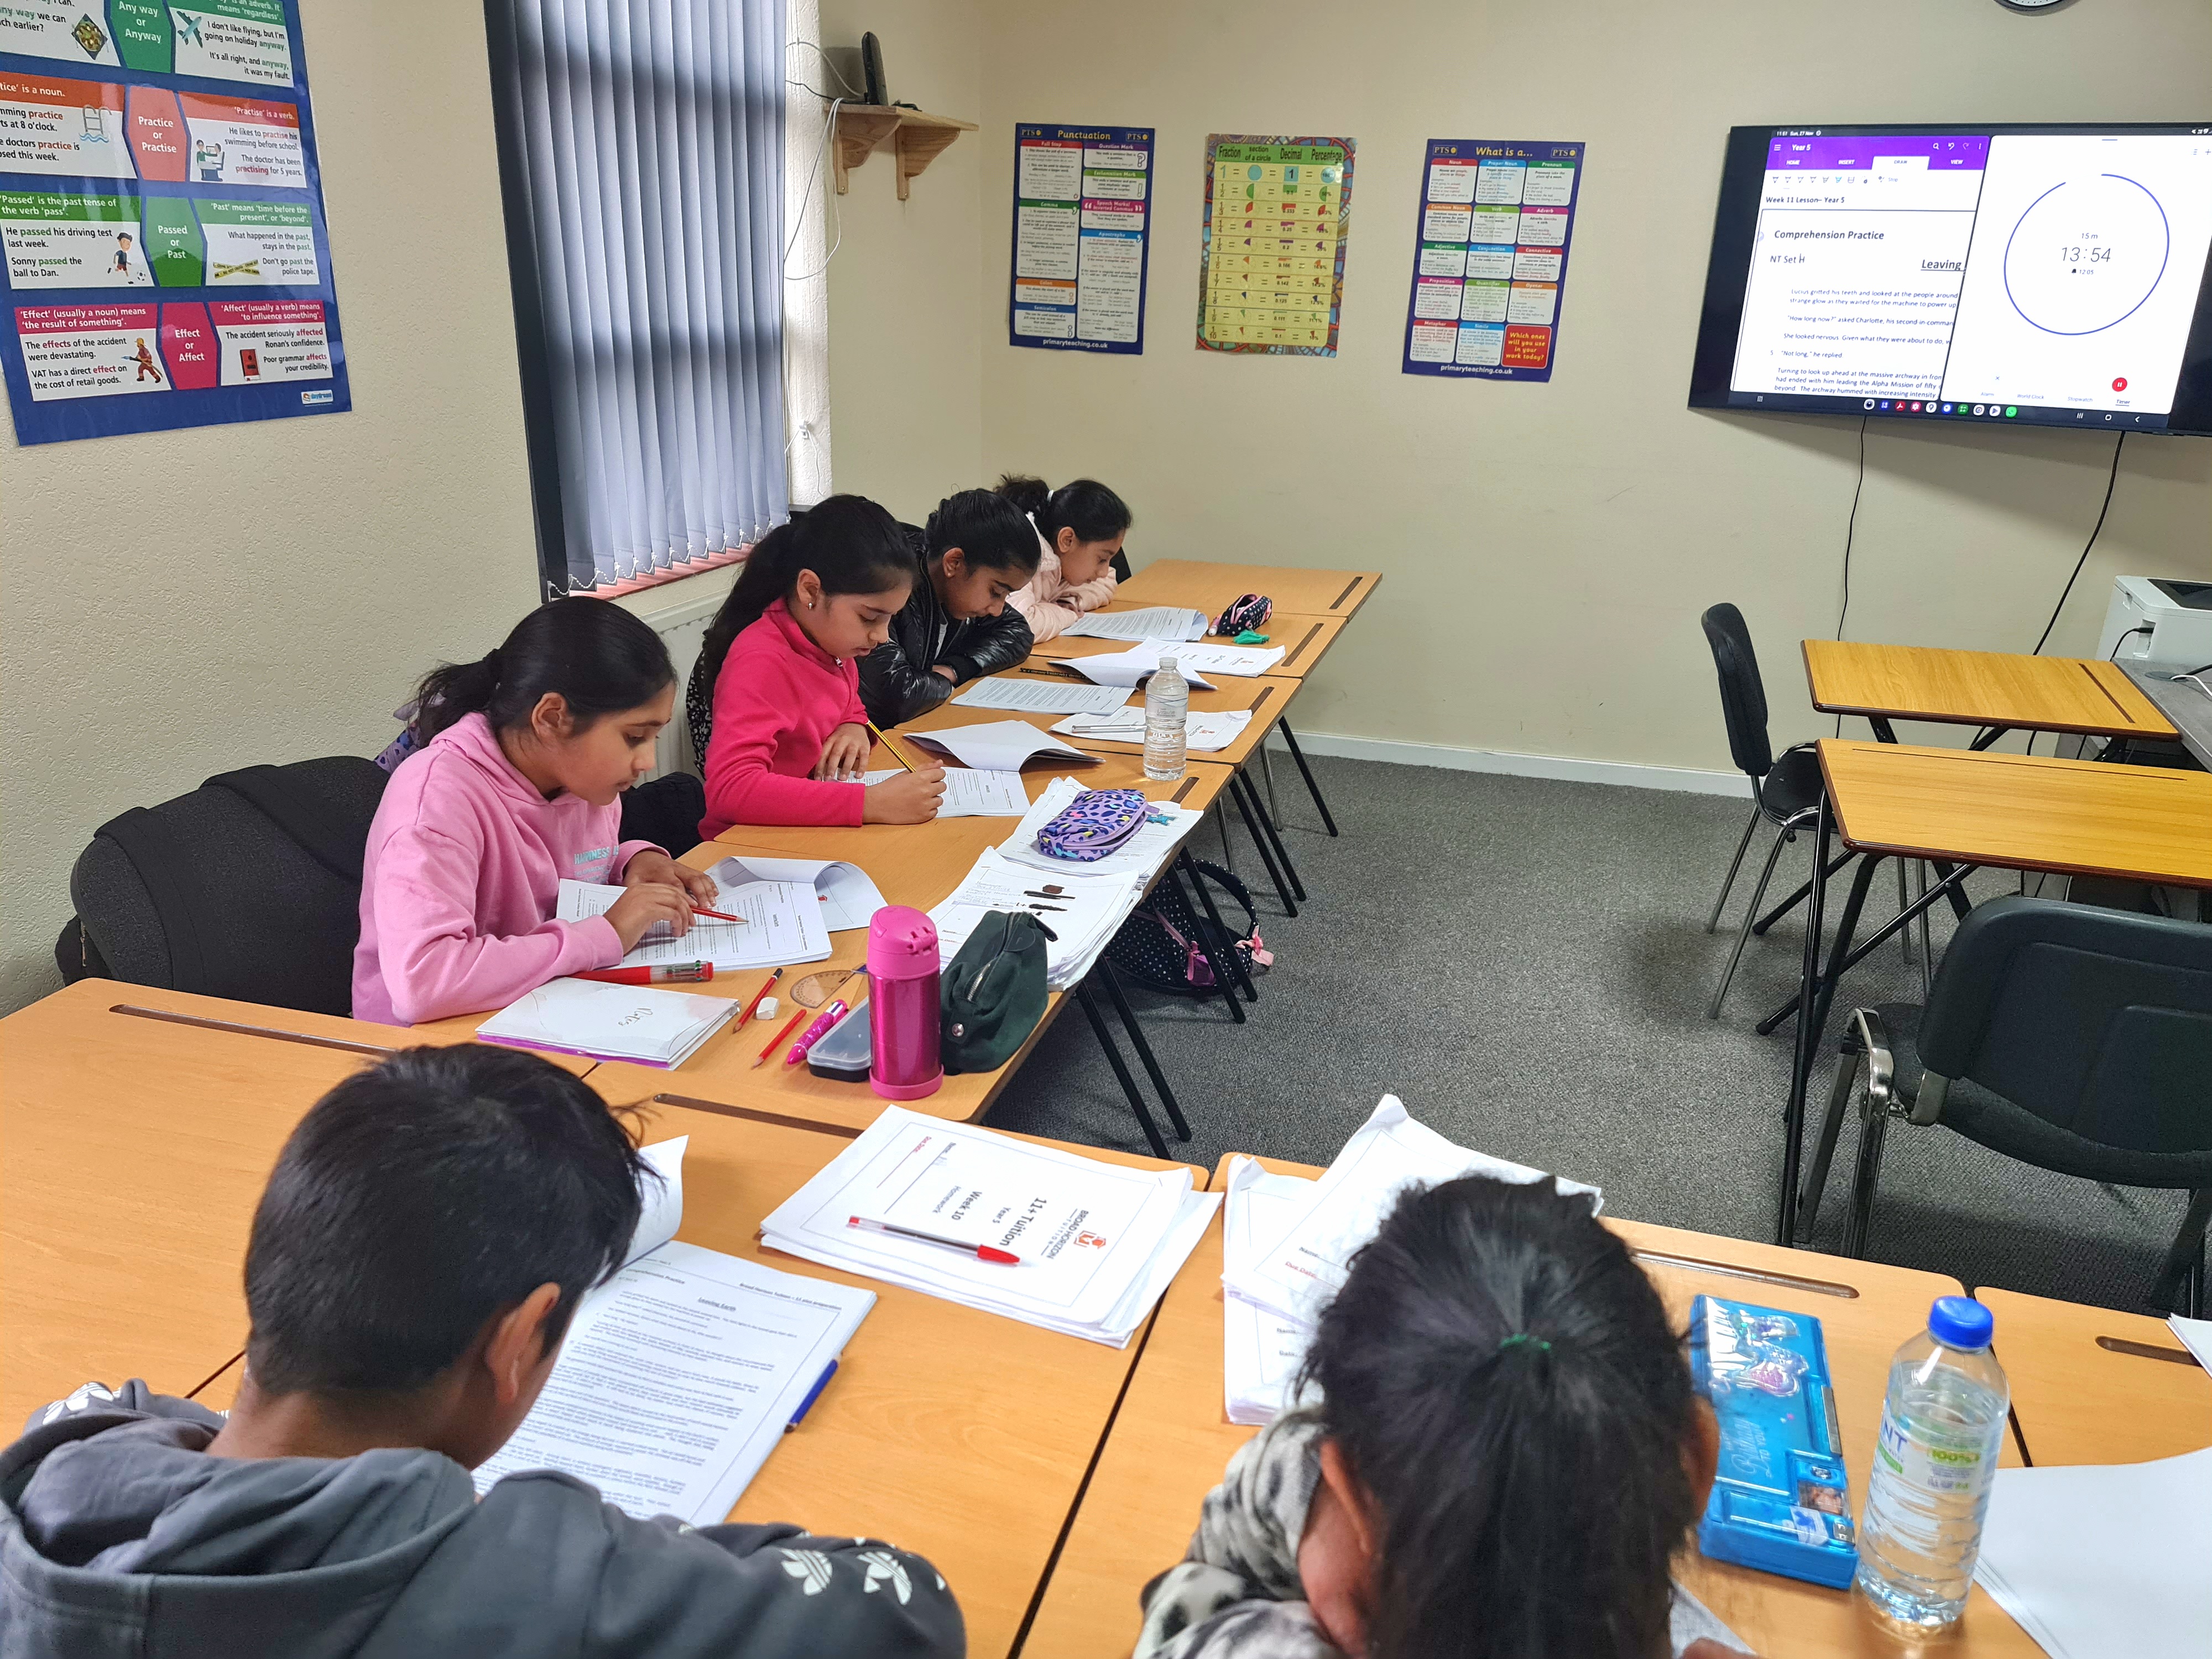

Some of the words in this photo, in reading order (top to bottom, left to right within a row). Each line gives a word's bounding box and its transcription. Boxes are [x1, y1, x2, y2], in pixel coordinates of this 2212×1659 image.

[119, 1, 136, 12] Any
[140, 6, 158, 17] way
[212, 22, 229, 30] don't
[230, 24, 241, 33] like
[243, 26, 262, 37] flying,
[264, 29, 274, 38] but
[126, 29, 161, 43] Anyway
[234, 107, 264, 117] 'Practise'
[139, 116, 173, 128] Practice
[1058, 131, 1110, 140] Punctuation
[142, 143, 176, 153] Practise
[1219, 146, 1241, 158] Fraction
[1475, 147, 1503, 156] What
[1281, 149, 1302, 159] Decimal
[1311, 149, 1342, 164] Percentage
[1288, 169, 1294, 179] 1
[1, 196, 34, 204] 'Passed'
[47, 197, 61, 205] the
[41, 208, 68, 217] 'pass'.
[6, 227, 18, 236] He
[20, 228, 51, 237] passed
[54, 228, 66, 236] his
[67, 228, 95, 238] driving
[158, 225, 187, 234] Passed
[1775, 231, 1845, 240] Comprehension
[1848, 231, 1884, 239] Practice
[8, 239, 23, 248] last
[168, 251, 186, 259] Past
[1799, 254, 1805, 263] H
[2062, 247, 2111, 263] 13:54
[1922, 260, 1961, 270] Leaving
[281, 303, 298, 311] verb)
[20, 310, 50, 319] 'Effect'
[54, 309, 86, 318] (usually
[95, 307, 118, 317] noun)
[22, 320, 39, 329] 'the
[79, 317, 127, 327] something'.
[175, 329, 200, 338] Effect
[25, 342, 40, 350] The
[43, 341, 71, 349] effects
[83, 338, 95, 347] the
[97, 337, 127, 346] accident
[1043, 339, 1108, 348] primaryteaching.co.uk
[50, 351, 96, 361] devastating.
[179, 353, 205, 362] Affect
[1441, 365, 1512, 375] primaryteaching.co.uk
[574, 847, 610, 864] HAPPINESS
[932, 1186, 961, 1213] Homework
[959, 1191, 982, 1209] Week
[1028, 1198, 1047, 1213] 11+
[952, 1211, 964, 1220] 10
[997, 1207, 1011, 1219] Year
[1069, 1210, 1089, 1231] BROAD
[999, 1215, 1034, 1246] Tuition
[1047, 1230, 1073, 1259] HORIZON
